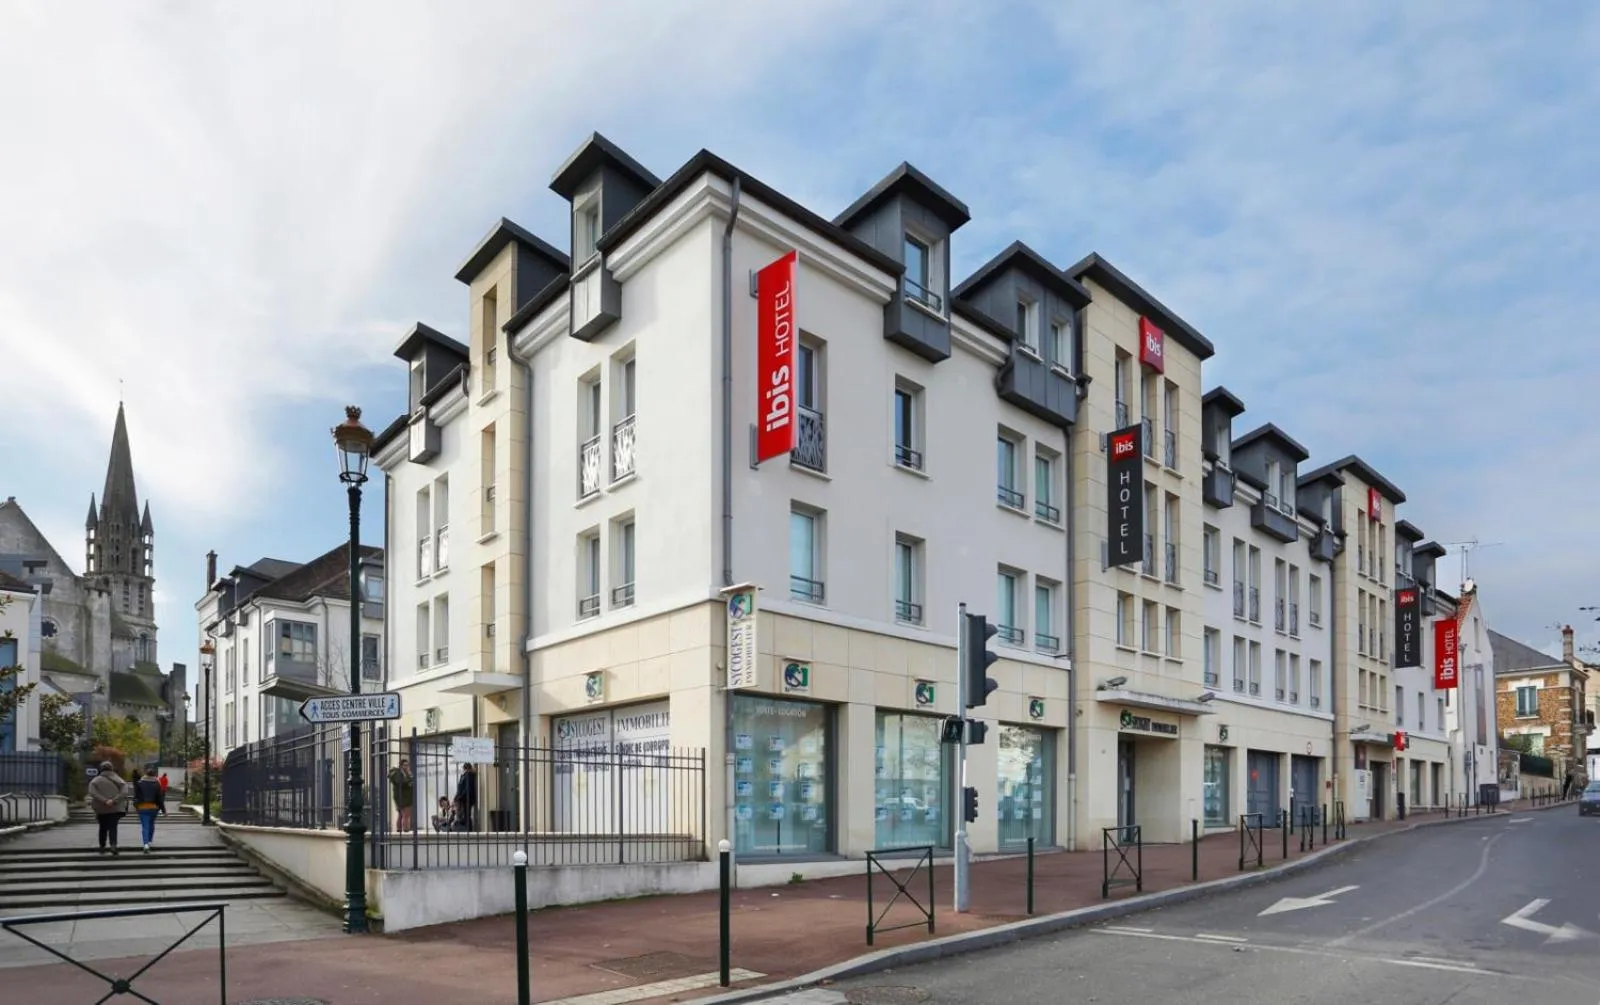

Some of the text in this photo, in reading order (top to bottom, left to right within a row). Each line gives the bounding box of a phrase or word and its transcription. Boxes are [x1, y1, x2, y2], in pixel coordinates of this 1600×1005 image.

[766, 279, 790, 432] ibis HOTEL
[1146, 331, 1161, 357] ibis
[1115, 442, 1134, 455] ibis
[1119, 471, 1130, 554] HOTEL
[730, 627, 743, 686] SYCOGEST
[1403, 612, 1412, 662] HOTEL
[1440, 628, 1455, 681] ibis HOTEL
[322, 709, 385, 719] TOUS COMMERCES
[342, 698, 366, 709] CENTRE
[368, 697, 386, 708] VILLE
